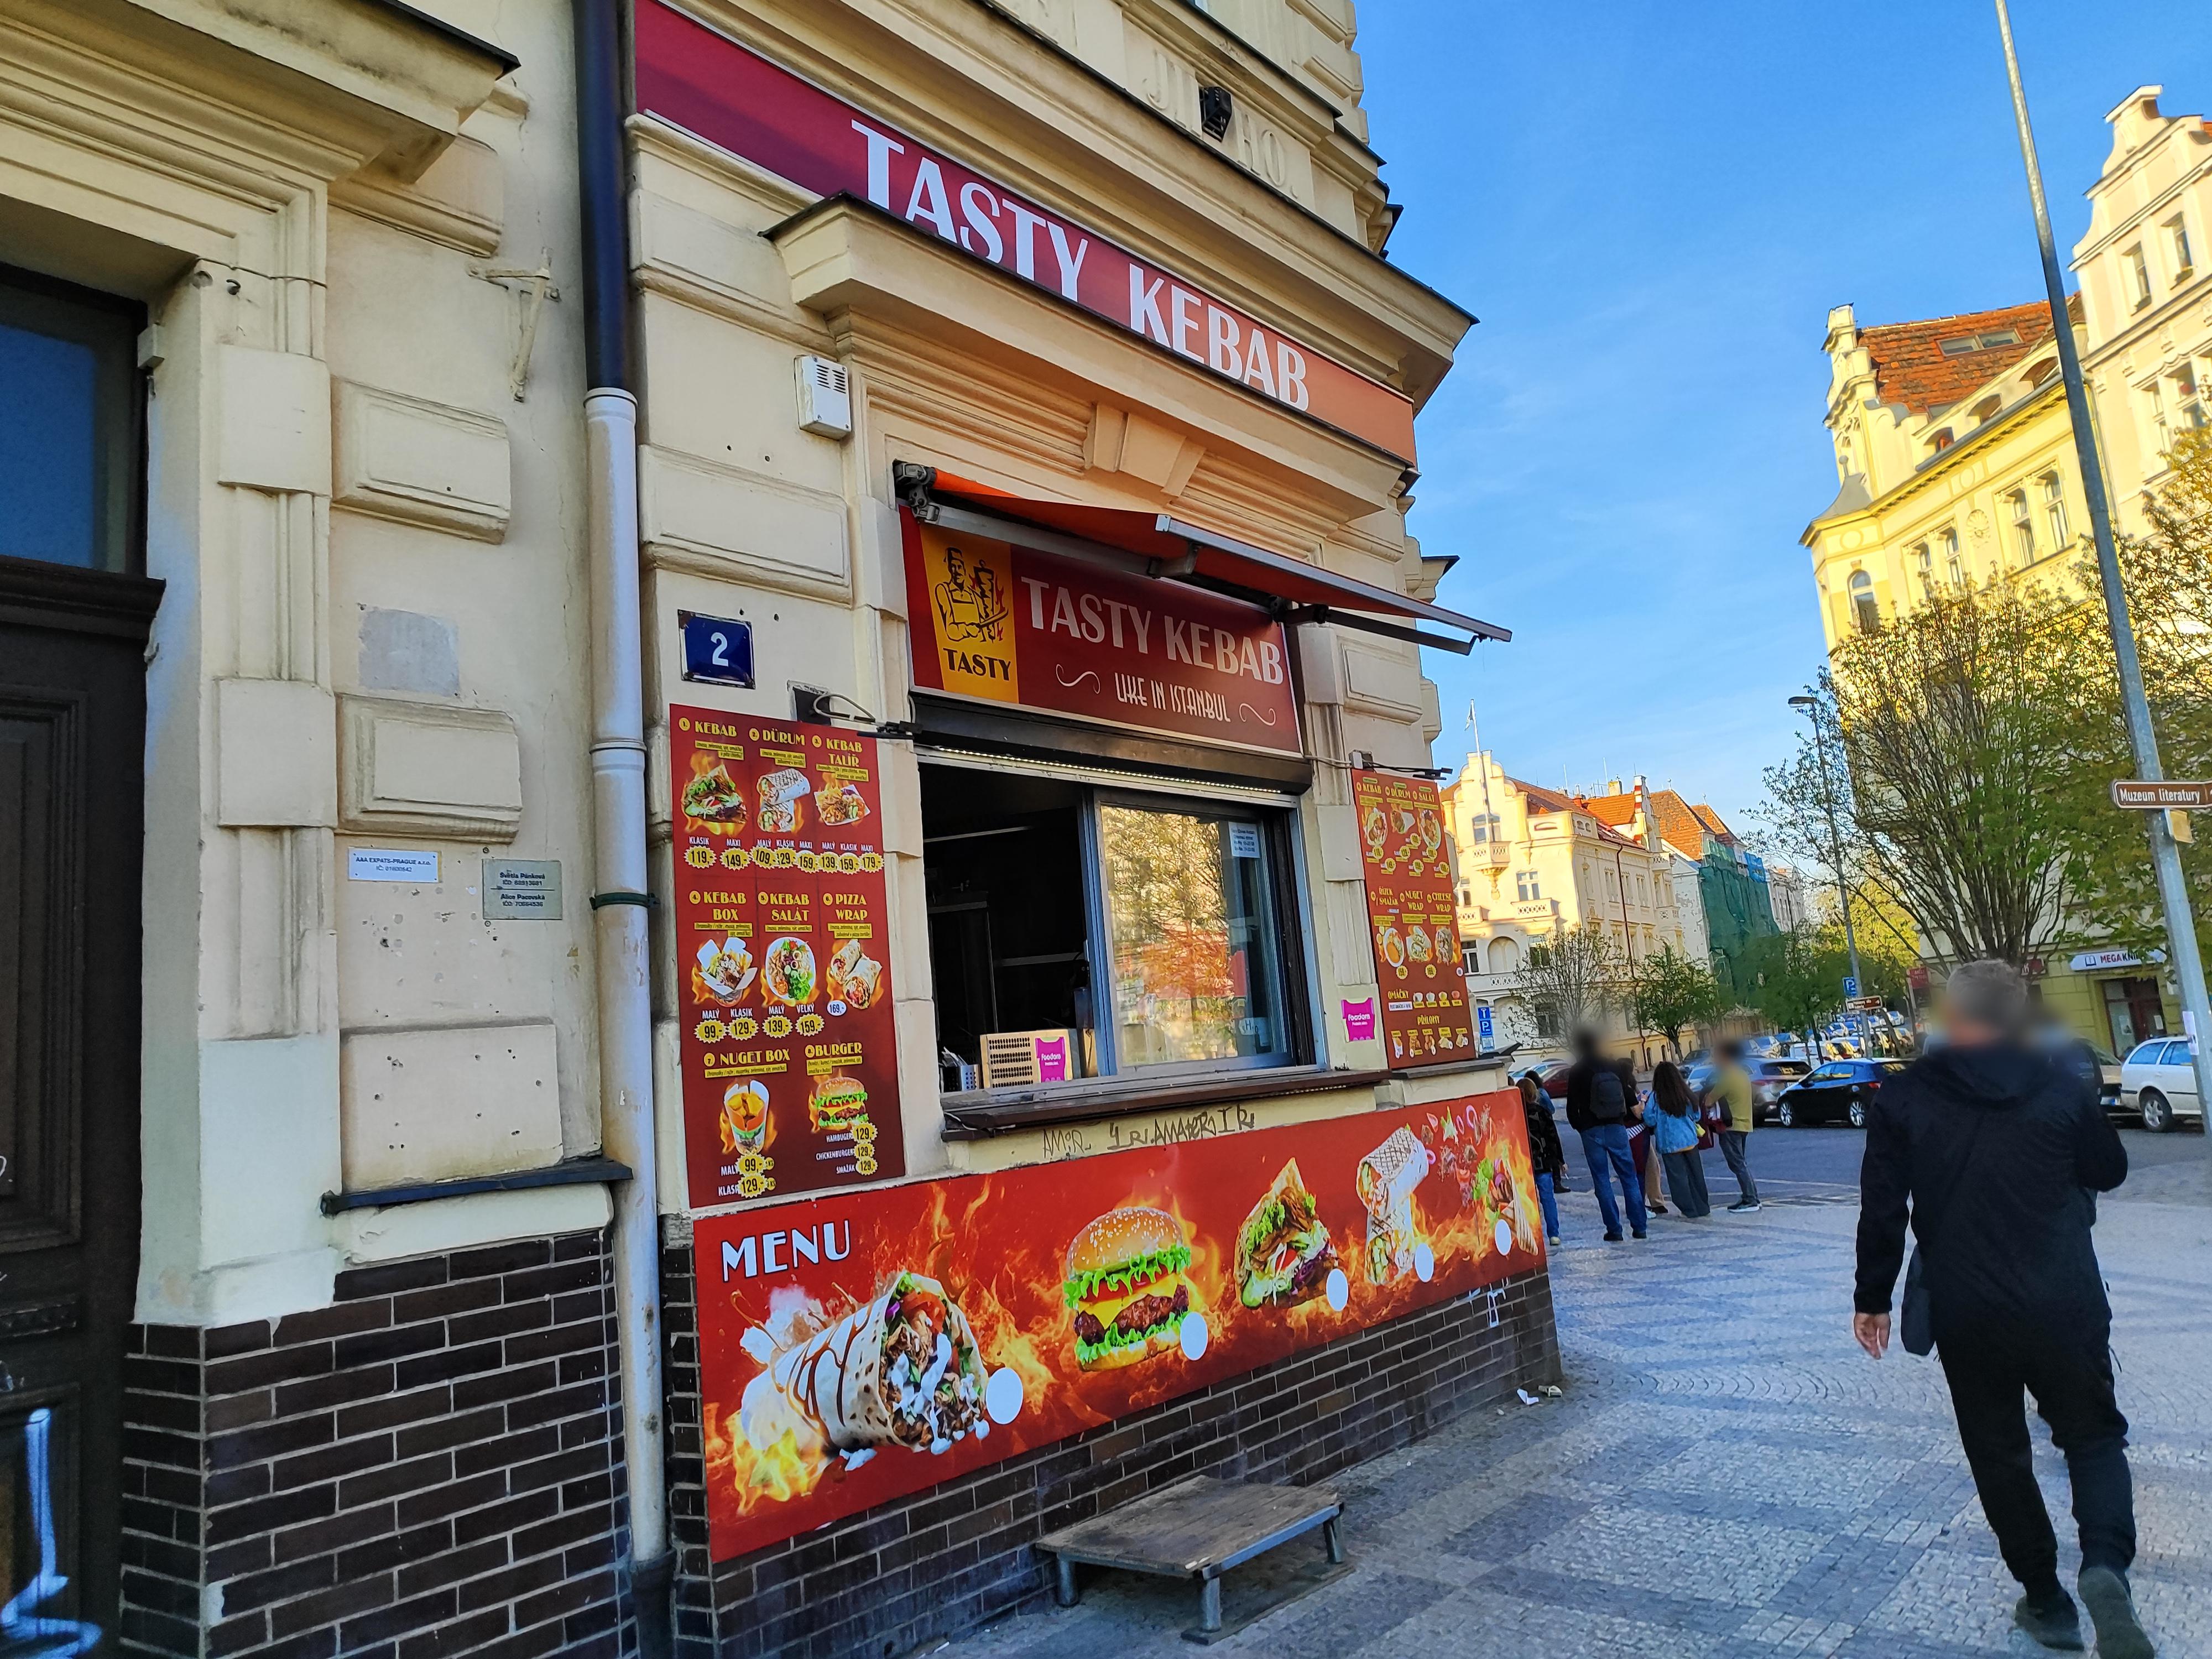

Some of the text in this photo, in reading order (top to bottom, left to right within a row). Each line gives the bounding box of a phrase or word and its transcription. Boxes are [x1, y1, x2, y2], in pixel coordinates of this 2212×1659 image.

[851, 119, 1310, 412] TASTY KEBAB
[1021, 575, 1284, 685] TASTY KEBAB
[711, 632, 728, 666] 2
[942, 646, 1011, 681] TASTY
[1114, 671, 1231, 723] LIKE IN ISTANBUL
[695, 721, 737, 737] KEBAB
[762, 728, 805, 745] DÜRUM
[826, 738, 863, 753] KEBAB
[2120, 788, 2200, 804] Muzeum literatury
[689, 836, 709, 845] KLASIK
[726, 838, 741, 847] MAXI
[776, 839, 795, 848] KLASIK
[799, 841, 813, 849] MAXI
[840, 843, 858, 851] KLASIK
[691, 850, 713, 864] 119,-
[726, 854, 747, 868] 149,-
[703, 891, 747, 904] KEBAB
[770, 893, 810, 905] KEBAB
[835, 893, 867, 905] PIZZA
[713, 909, 739, 921] BOX
[771, 907, 810, 921] SALÁT
[836, 909, 868, 921] WRAP
[730, 1008, 753, 1018] KLASIK
[815, 1042, 863, 1057] BURGER
[1041, 1052, 1061, 1061] foodora
[720, 1050, 763, 1066] NUGET
[765, 1048, 790, 1062] BOX
[722, 1219, 850, 1282] MENU
